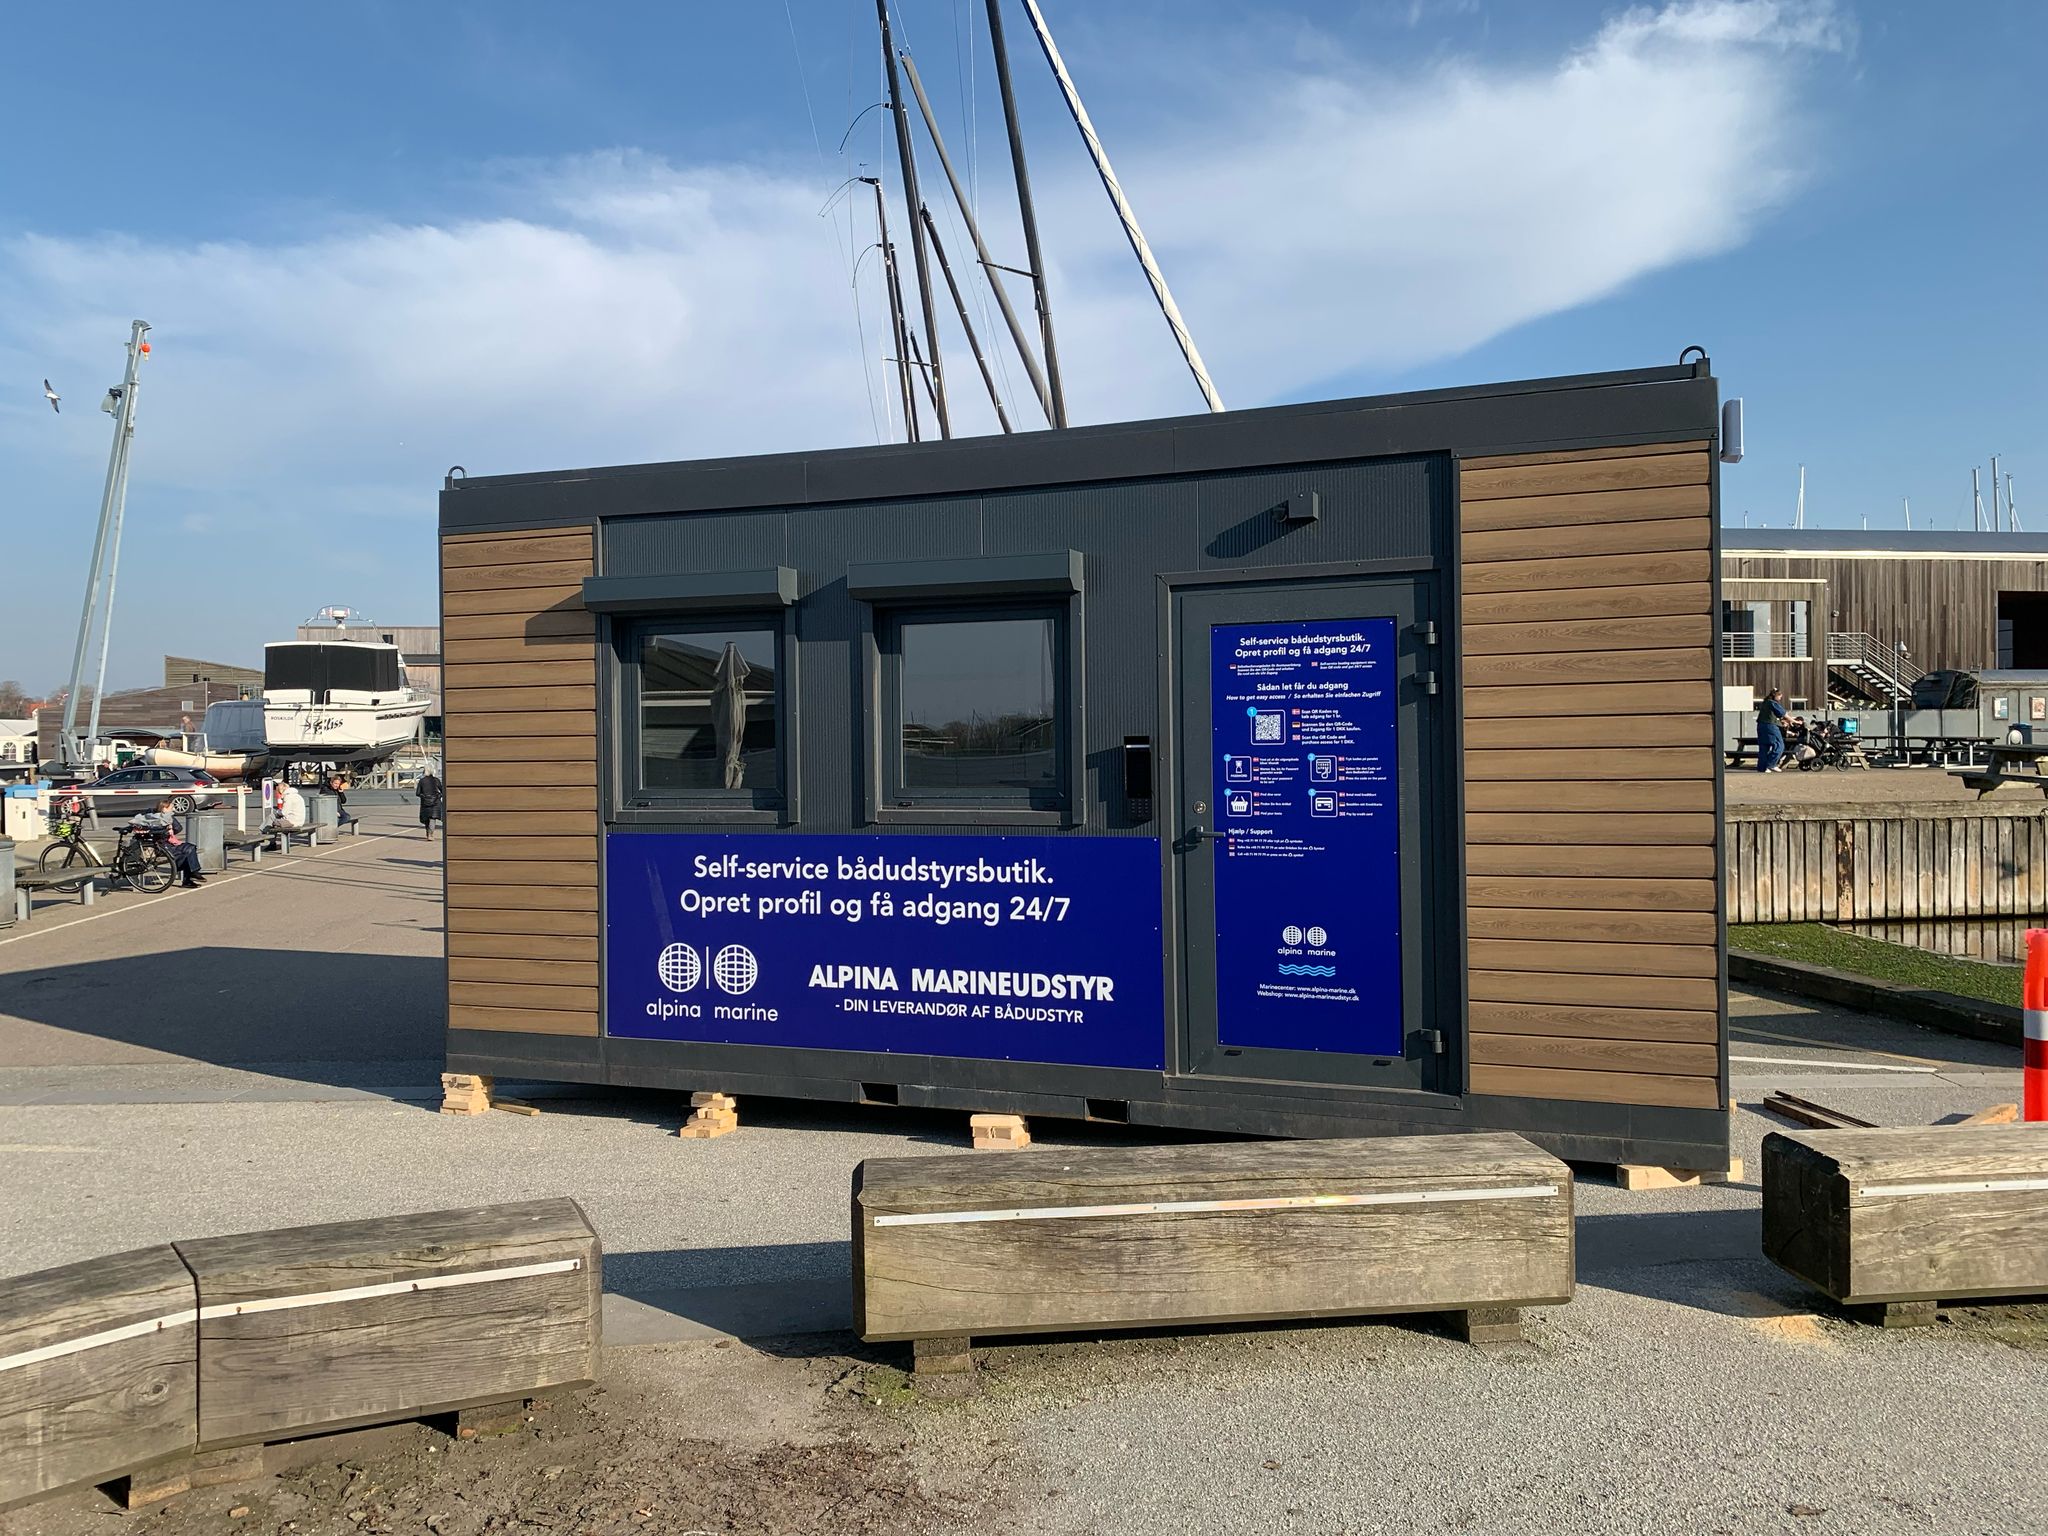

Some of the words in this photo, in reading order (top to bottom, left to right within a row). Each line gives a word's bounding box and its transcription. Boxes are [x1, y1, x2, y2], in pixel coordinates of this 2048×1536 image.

[1235, 648, 1261, 659] Opret
[1263, 646, 1286, 658] profil
[1289, 648, 1300, 656] og
[1303, 646, 1312, 655] få
[1314, 645, 1347, 655] adgang
[1350, 644, 1371, 653] 24/7
[1240, 637, 1289, 646] Self-service
[1291, 633, 1365, 645] bådudstyrsbutik.
[1294, 682, 1305, 690] får
[1319, 682, 1348, 691] adgang
[693, 854, 829, 880] Self-service
[837, 856, 1054, 888] bådudstyrsbutik.
[679, 890, 751, 918] Opret
[759, 890, 822, 919] profil
[830, 896, 862, 919] og
[870, 891, 895, 916] få
[902, 893, 1000, 926] adgang
[1009, 896, 1071, 922] 24/7
[1277, 947, 1303, 956] alpina
[808, 964, 898, 990] ALPINA
[911, 968, 1115, 1001] MARINEUDSTYR
[645, 997, 702, 1022] alpina
[714, 1004, 779, 1022] marine
[842, 998, 870, 1013] DIN
[873, 999, 969, 1017] LEVERANDØR
[971, 1004, 990, 1018] AF
[994, 1002, 1085, 1023] BÅDUDSTYR
